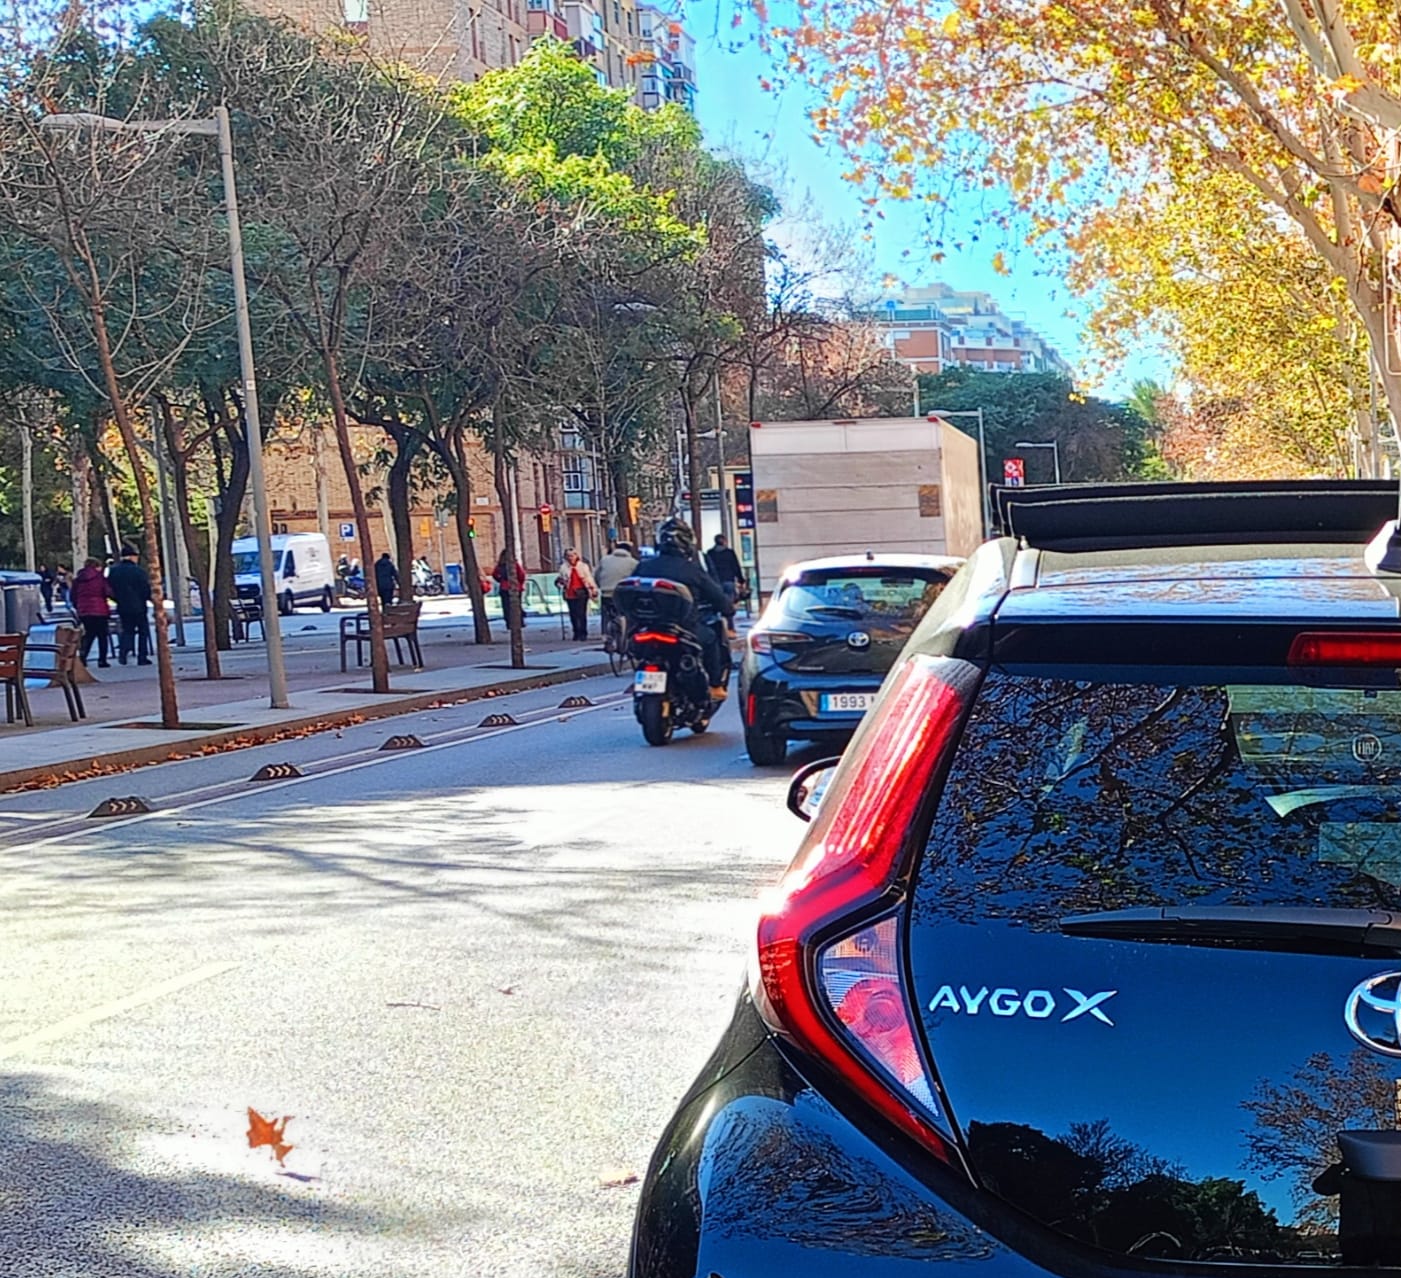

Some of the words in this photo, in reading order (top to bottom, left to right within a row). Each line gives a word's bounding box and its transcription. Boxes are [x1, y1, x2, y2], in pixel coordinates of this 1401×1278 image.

[342, 524, 350, 536] P
[833, 696, 867, 708] 1993
[928, 985, 1056, 1018] AYGO
[1060, 987, 1118, 1026] X
